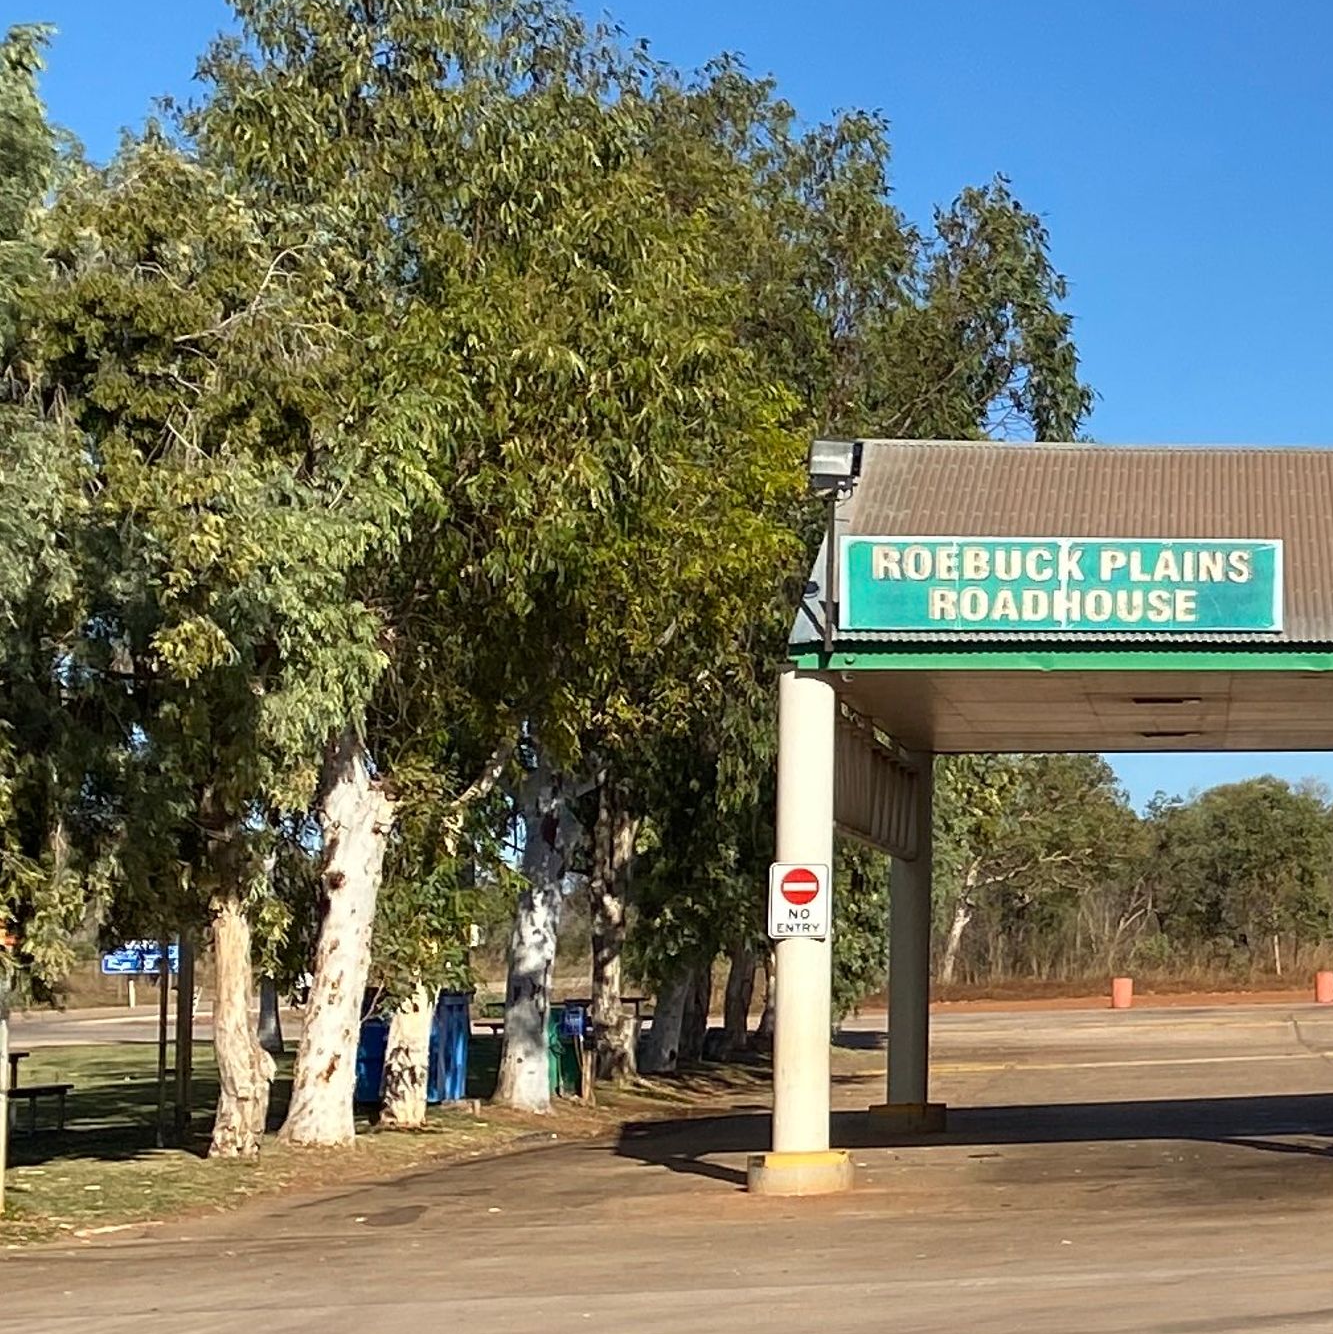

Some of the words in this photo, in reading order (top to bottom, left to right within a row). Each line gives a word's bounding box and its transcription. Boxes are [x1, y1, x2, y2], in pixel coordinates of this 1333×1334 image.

[872, 544, 1085, 582] ROEBUCK
[1100, 548, 1254, 584] PLAINS
[929, 586, 1199, 623] ROADHOUSE
[788, 908, 810, 920] NO
[776, 923, 820, 934] ENTRY
